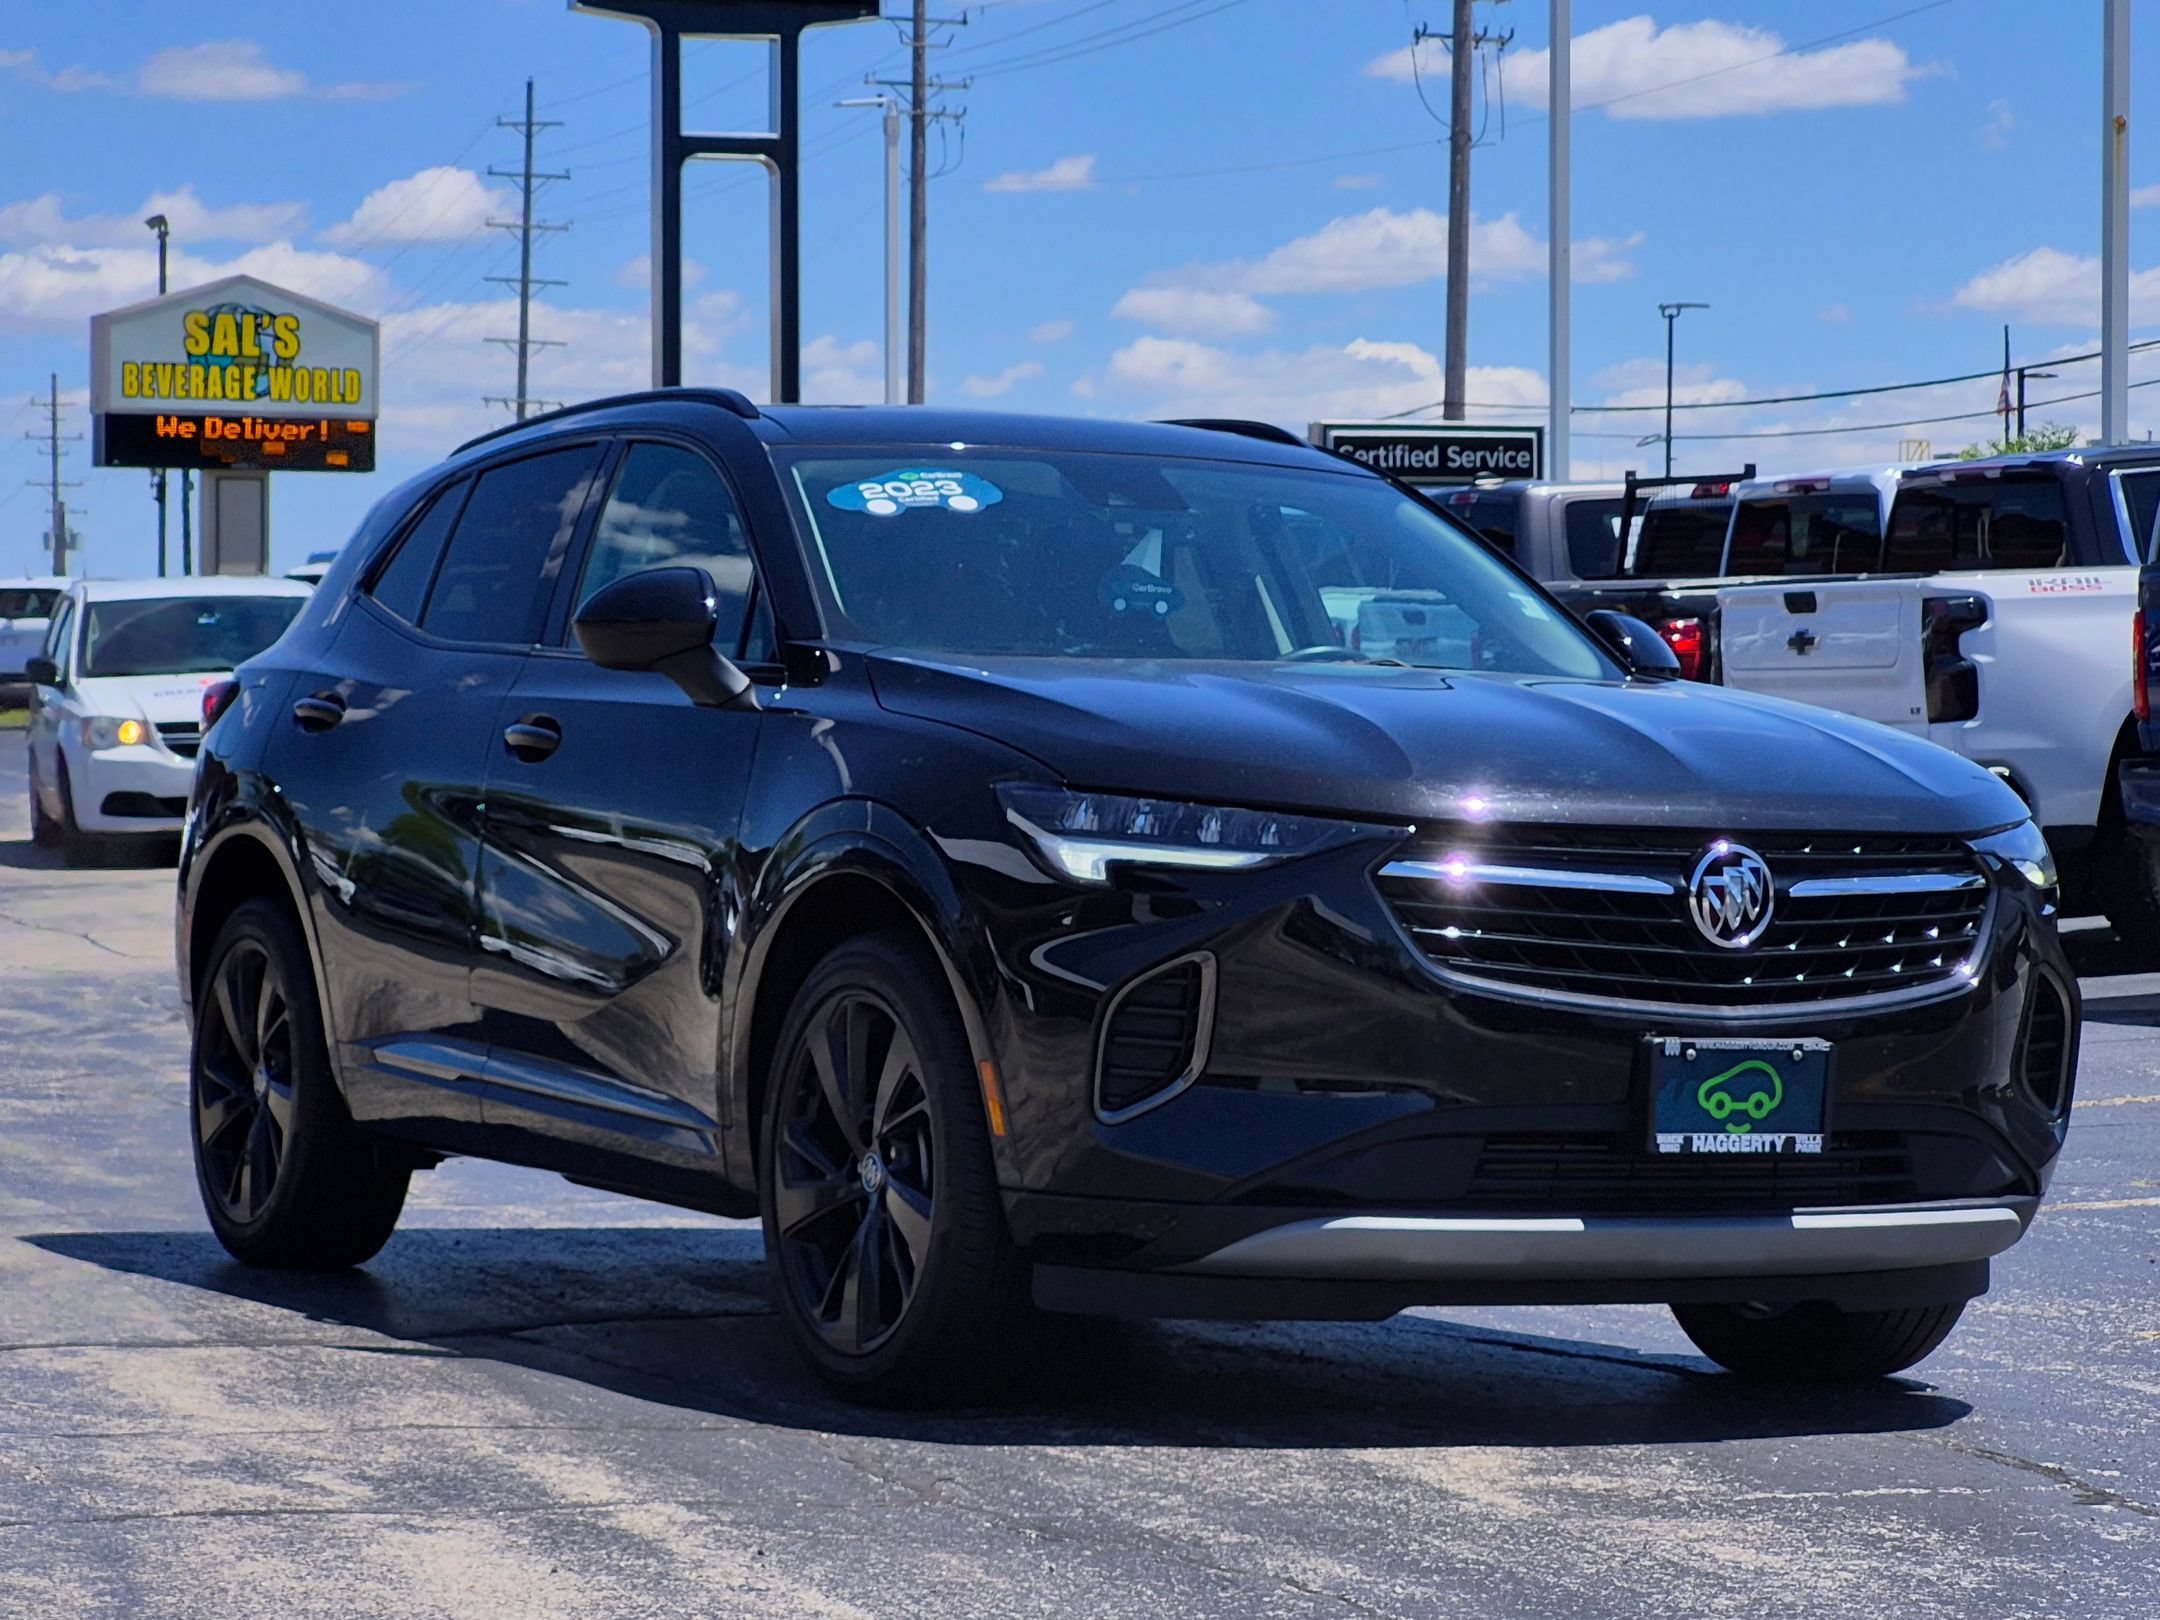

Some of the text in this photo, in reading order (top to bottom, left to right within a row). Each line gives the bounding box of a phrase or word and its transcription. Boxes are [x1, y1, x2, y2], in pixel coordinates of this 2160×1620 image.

[184, 311, 300, 359] SAL'S
[122, 361, 361, 403] BEVERAGE WORLD
[155, 416, 197, 438] We
[1446, 446, 1530, 468] Service
[858, 480, 963, 498] 2023
[1692, 1134, 1786, 1153] HAGGERTY
